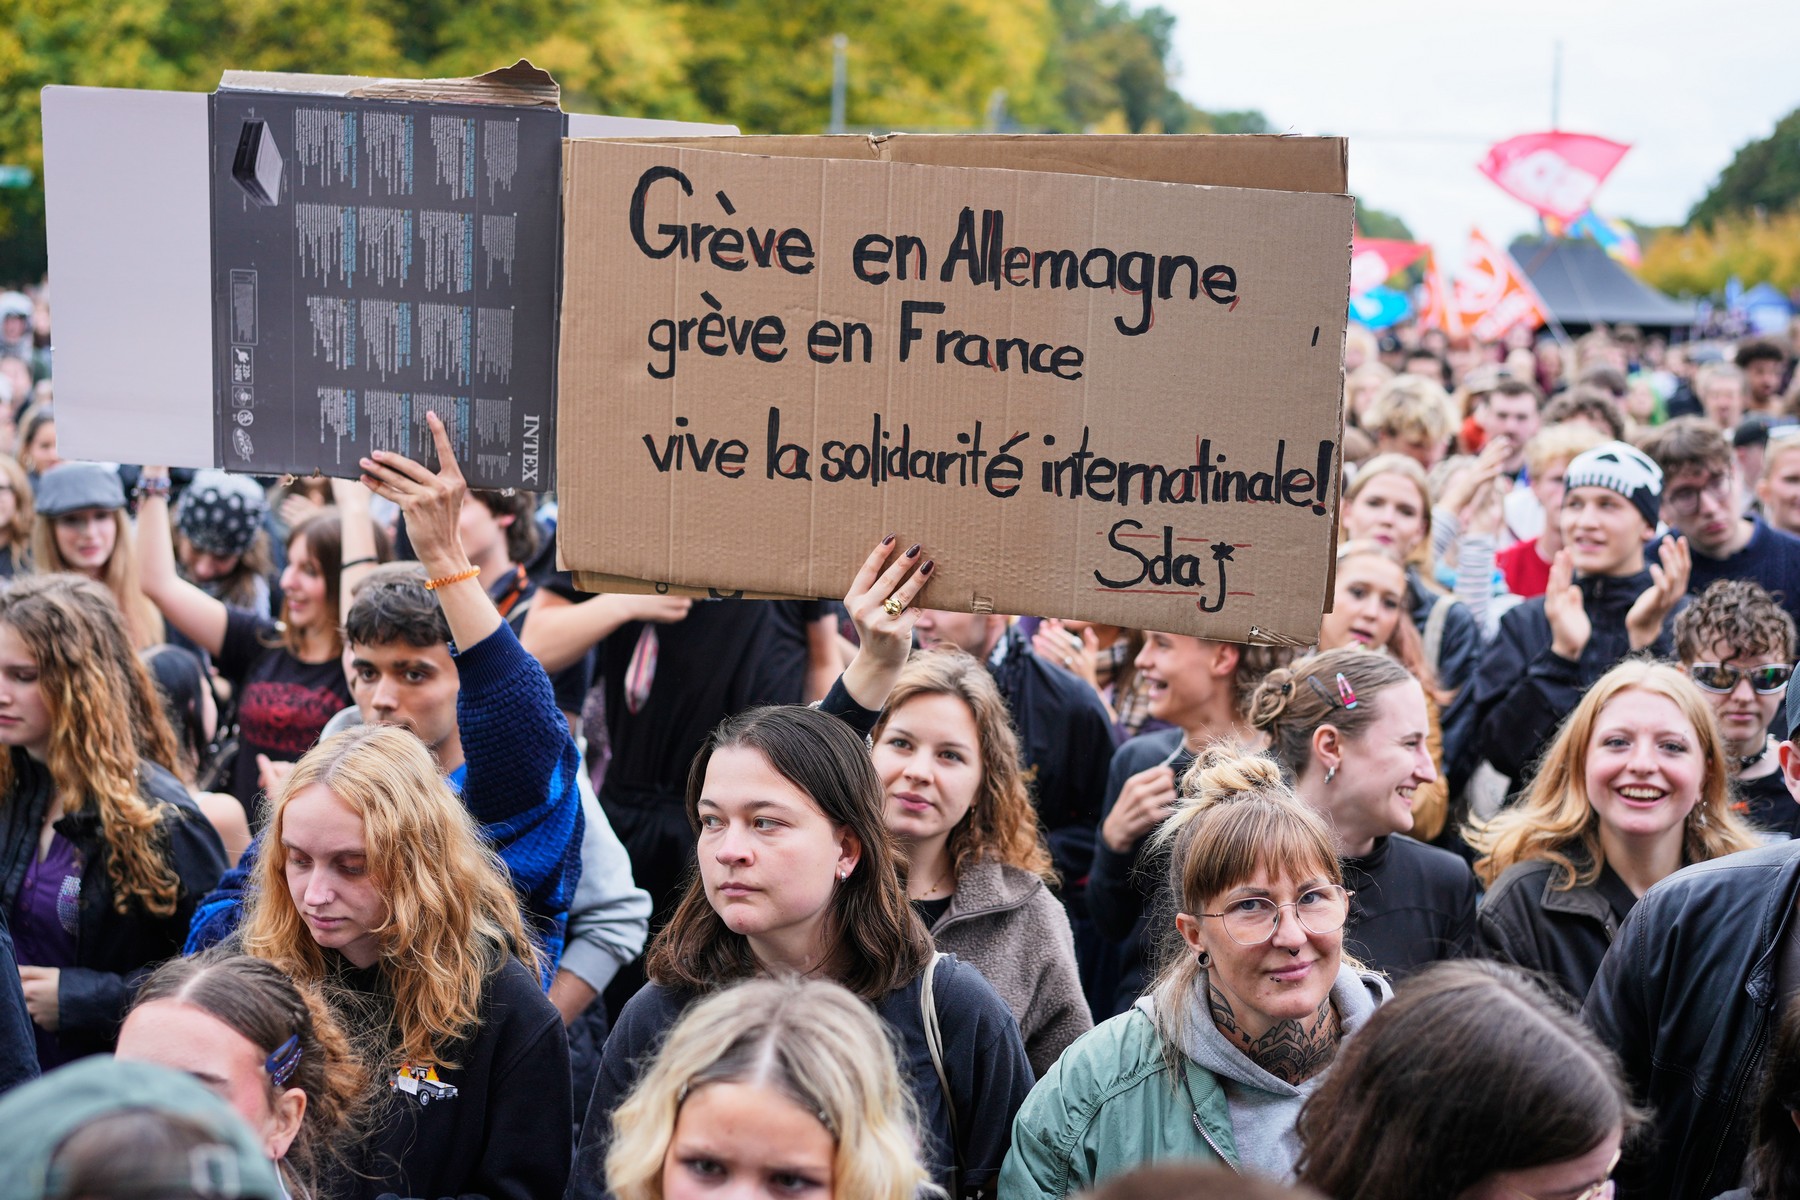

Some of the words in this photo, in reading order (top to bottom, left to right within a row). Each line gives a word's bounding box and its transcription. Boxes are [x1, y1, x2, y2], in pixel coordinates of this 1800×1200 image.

[630, 165, 815, 275] Grève
[852, 233, 928, 286] en
[939, 206, 1237, 337] Allemagne
[647, 290, 788, 380] grève
[807, 319, 873, 364] en
[899, 300, 1084, 381] France
[521, 413, 541, 484] INTEX
[642, 416, 749, 481] vive
[766, 406, 813, 481] la
[820, 412, 1030, 499] solidarité
[1041, 425, 1335, 517] internatinale!
